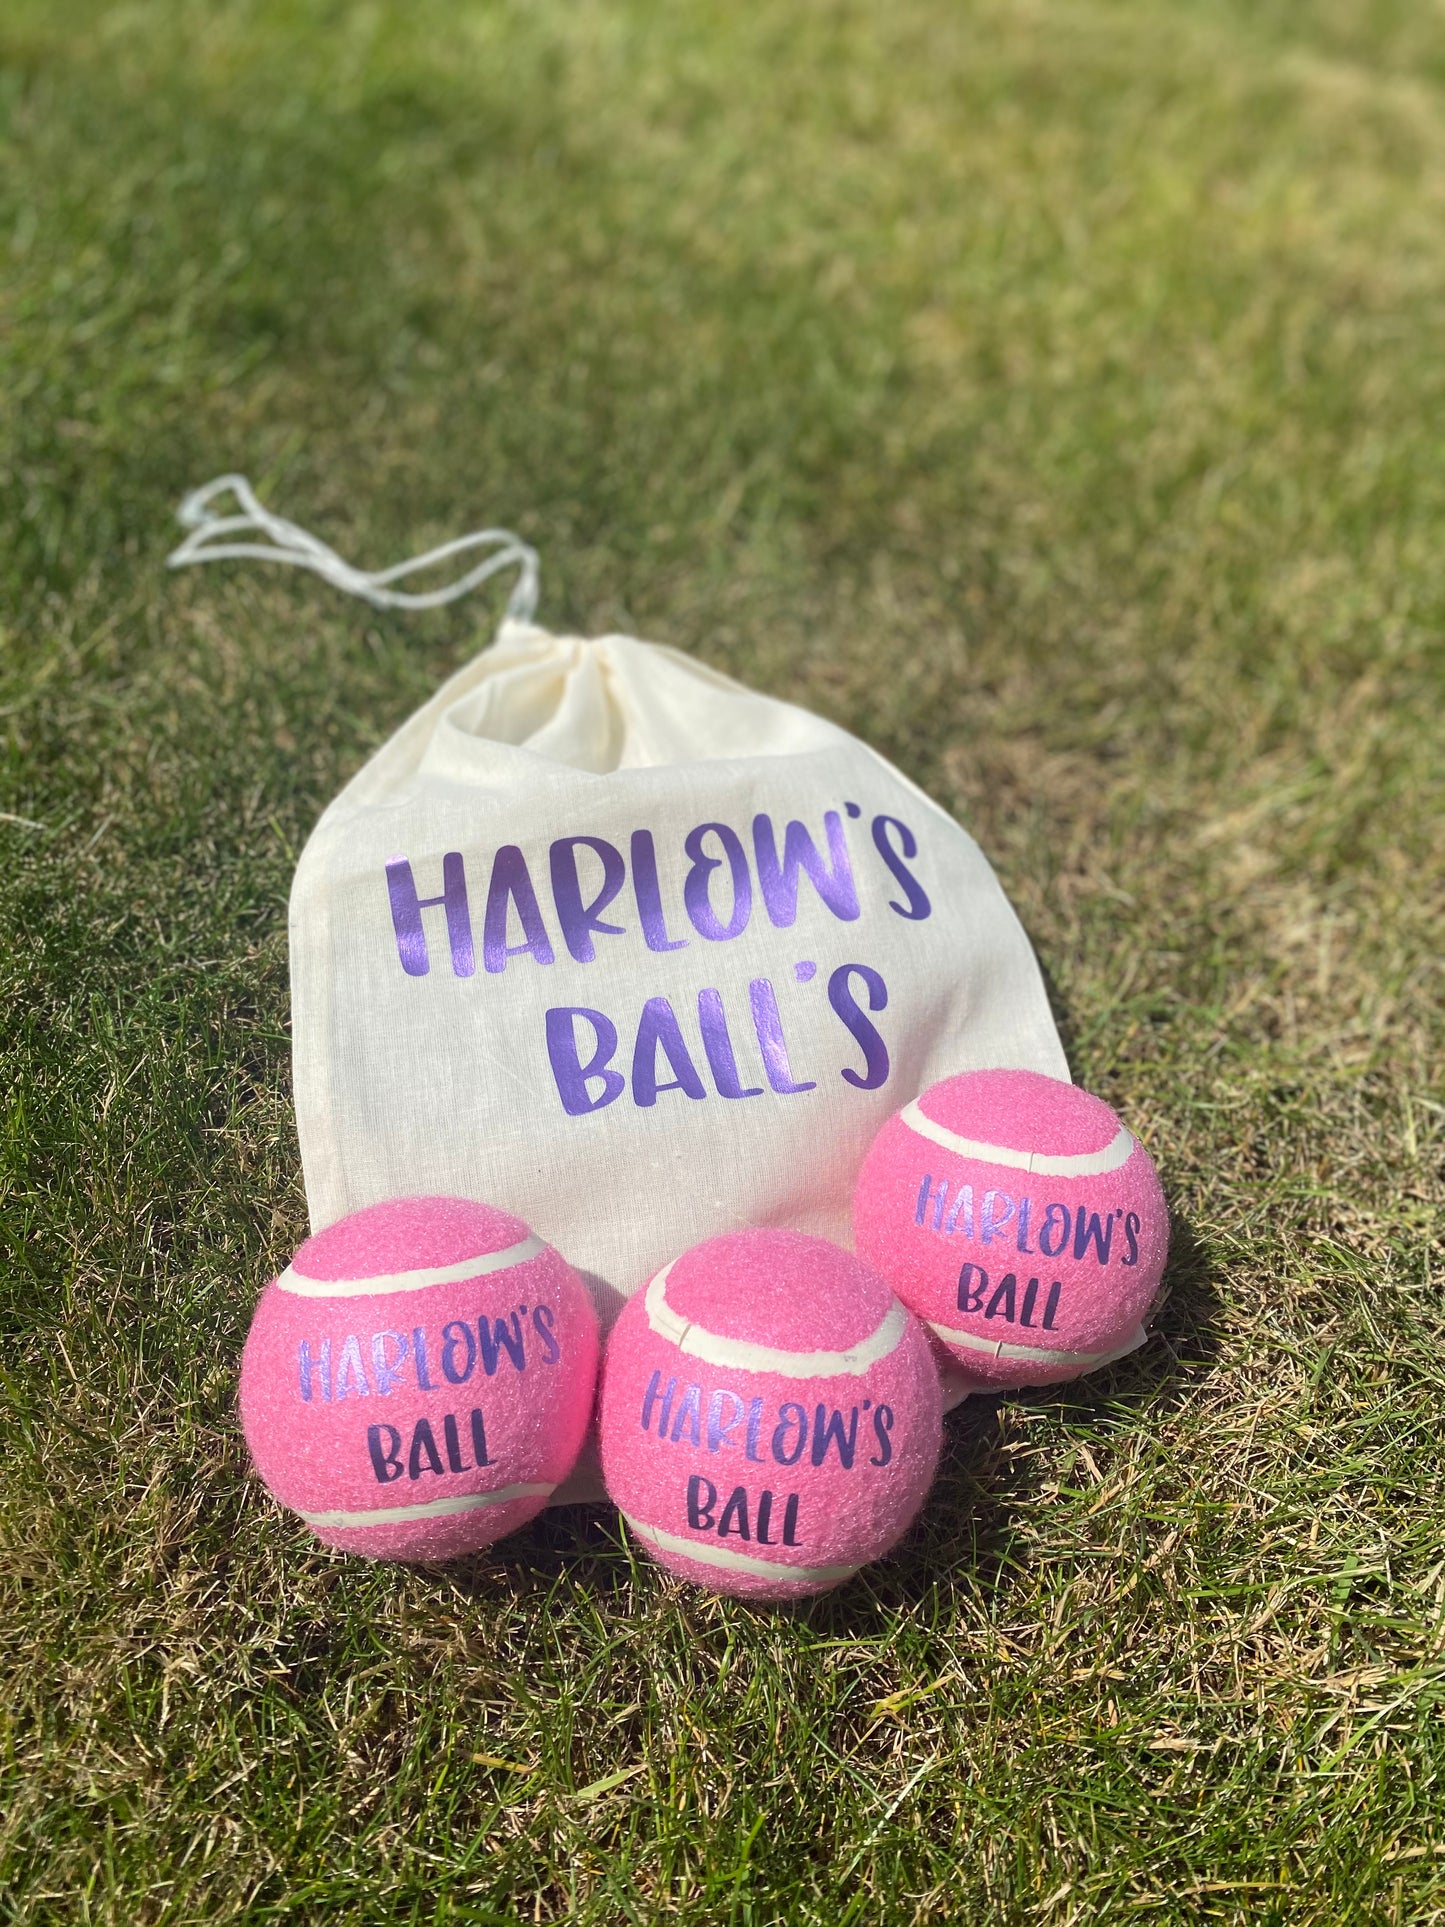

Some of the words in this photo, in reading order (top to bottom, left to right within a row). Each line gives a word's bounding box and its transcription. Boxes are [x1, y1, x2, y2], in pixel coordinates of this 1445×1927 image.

[385, 802, 931, 977] HARLOW'S
[545, 961, 889, 1116] BALL'S
[915, 1174, 1140, 1266] HARLOW'S
[957, 1262, 1062, 1331] BALL
[299, 1305, 560, 1402] HARLOW'S
[367, 1408, 498, 1484] BALL
[641, 1369, 894, 1470] HARLOW'S
[687, 1474, 803, 1547] BALL
